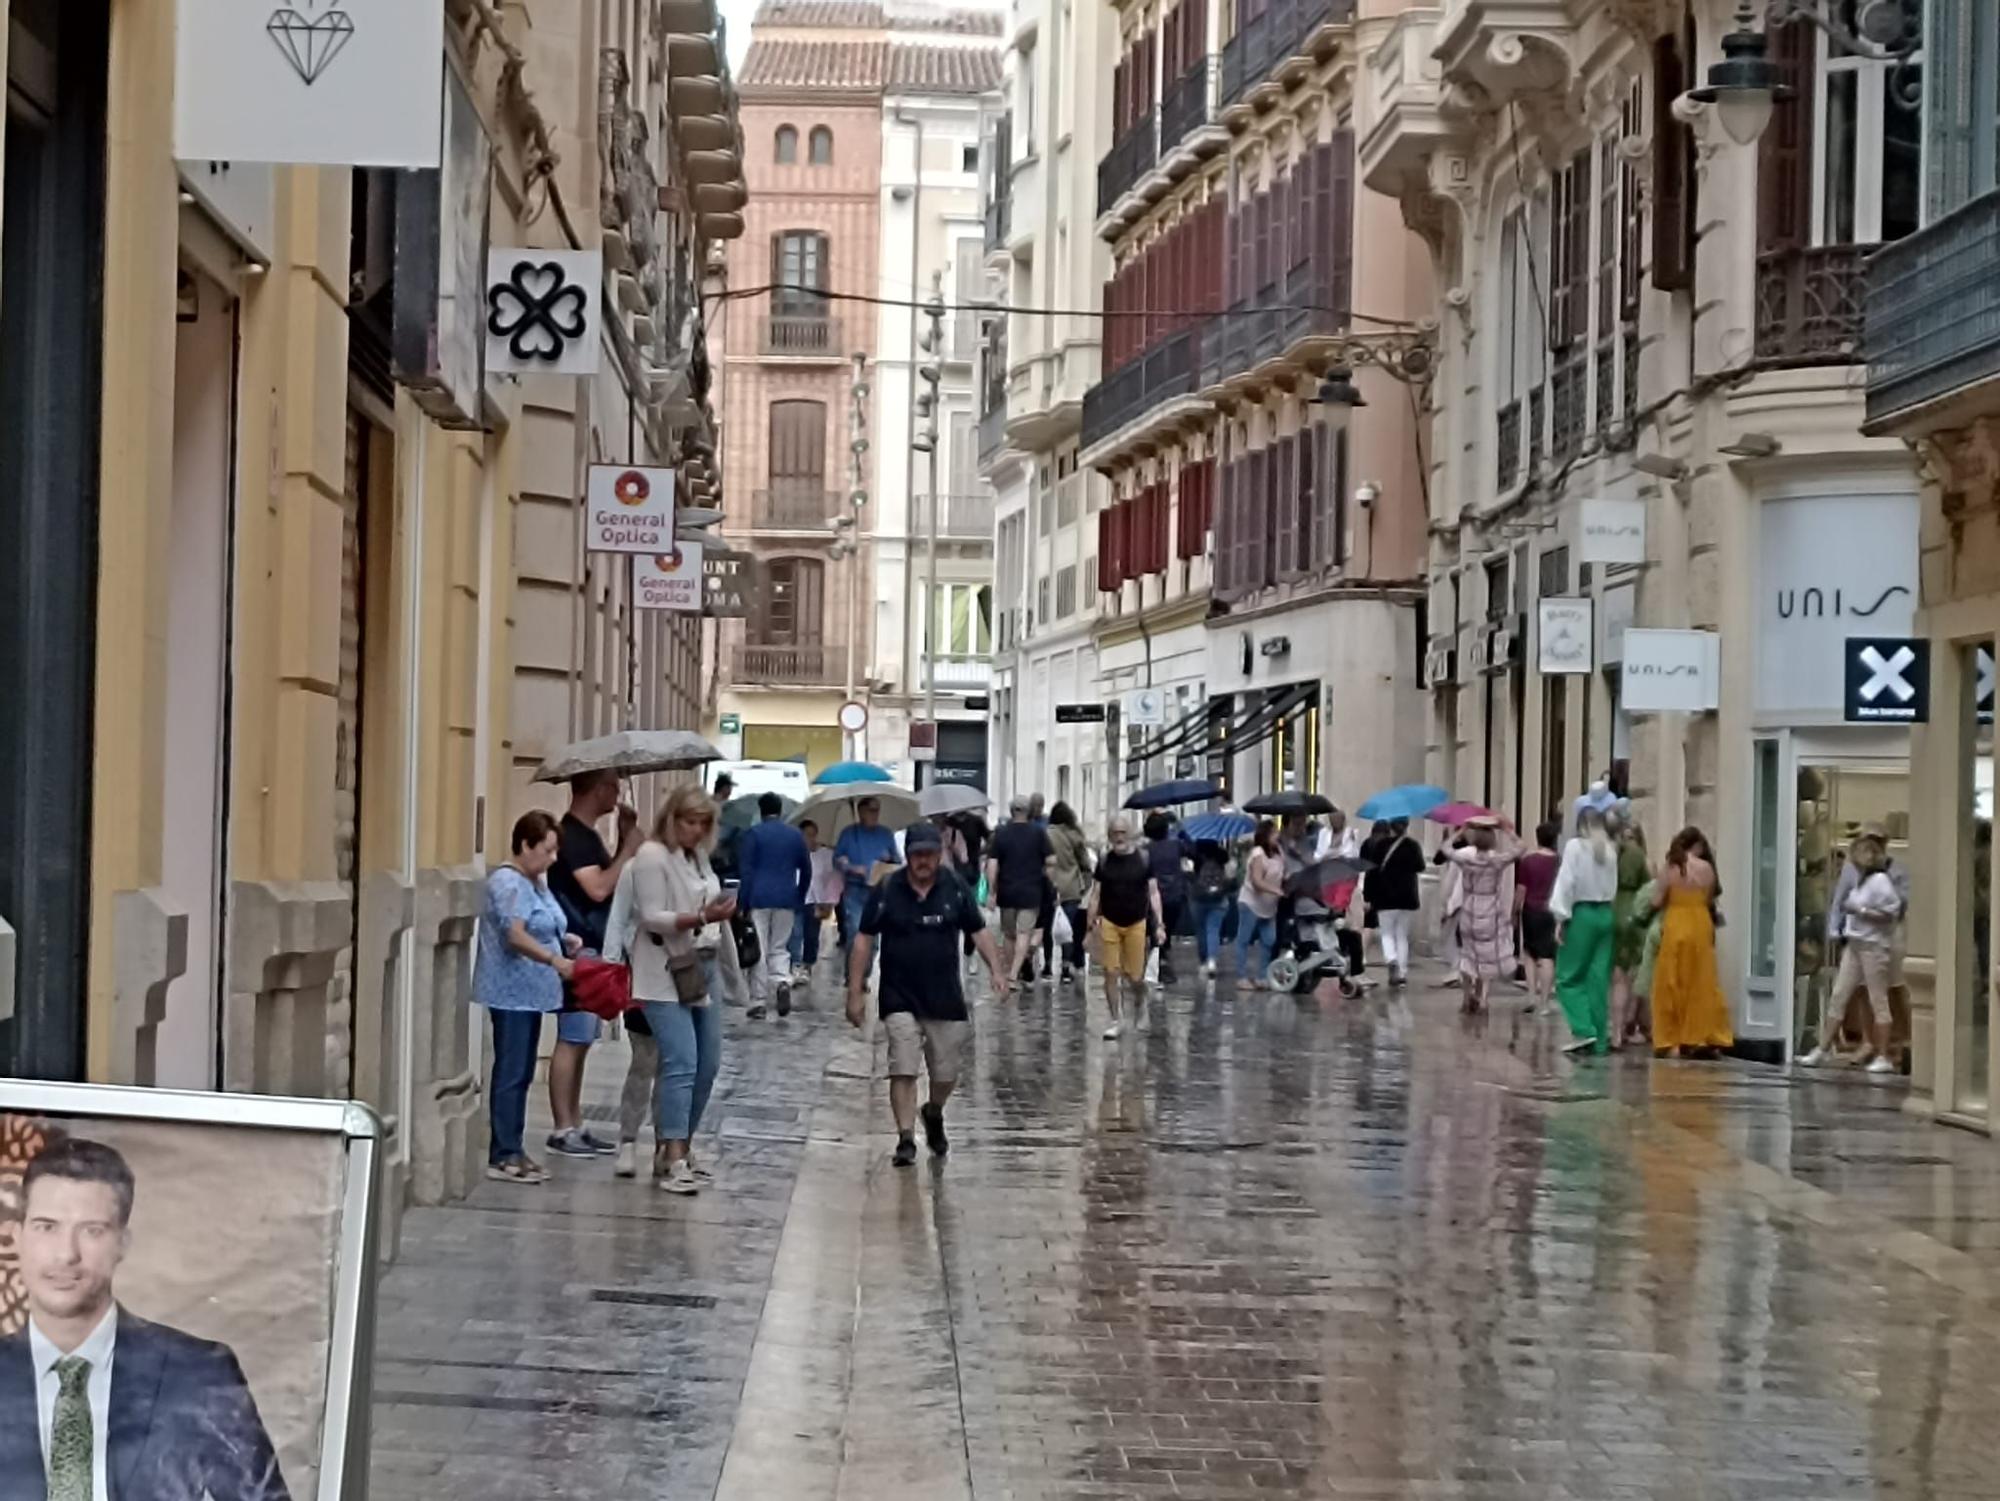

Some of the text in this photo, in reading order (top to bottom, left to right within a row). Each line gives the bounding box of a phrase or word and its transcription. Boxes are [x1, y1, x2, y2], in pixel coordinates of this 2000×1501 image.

[596, 510, 665, 527] General
[601, 528, 659, 545] Optica
[703, 560, 741, 575] UNT
[639, 576, 695, 589] General
[644, 590, 691, 605] Optica
